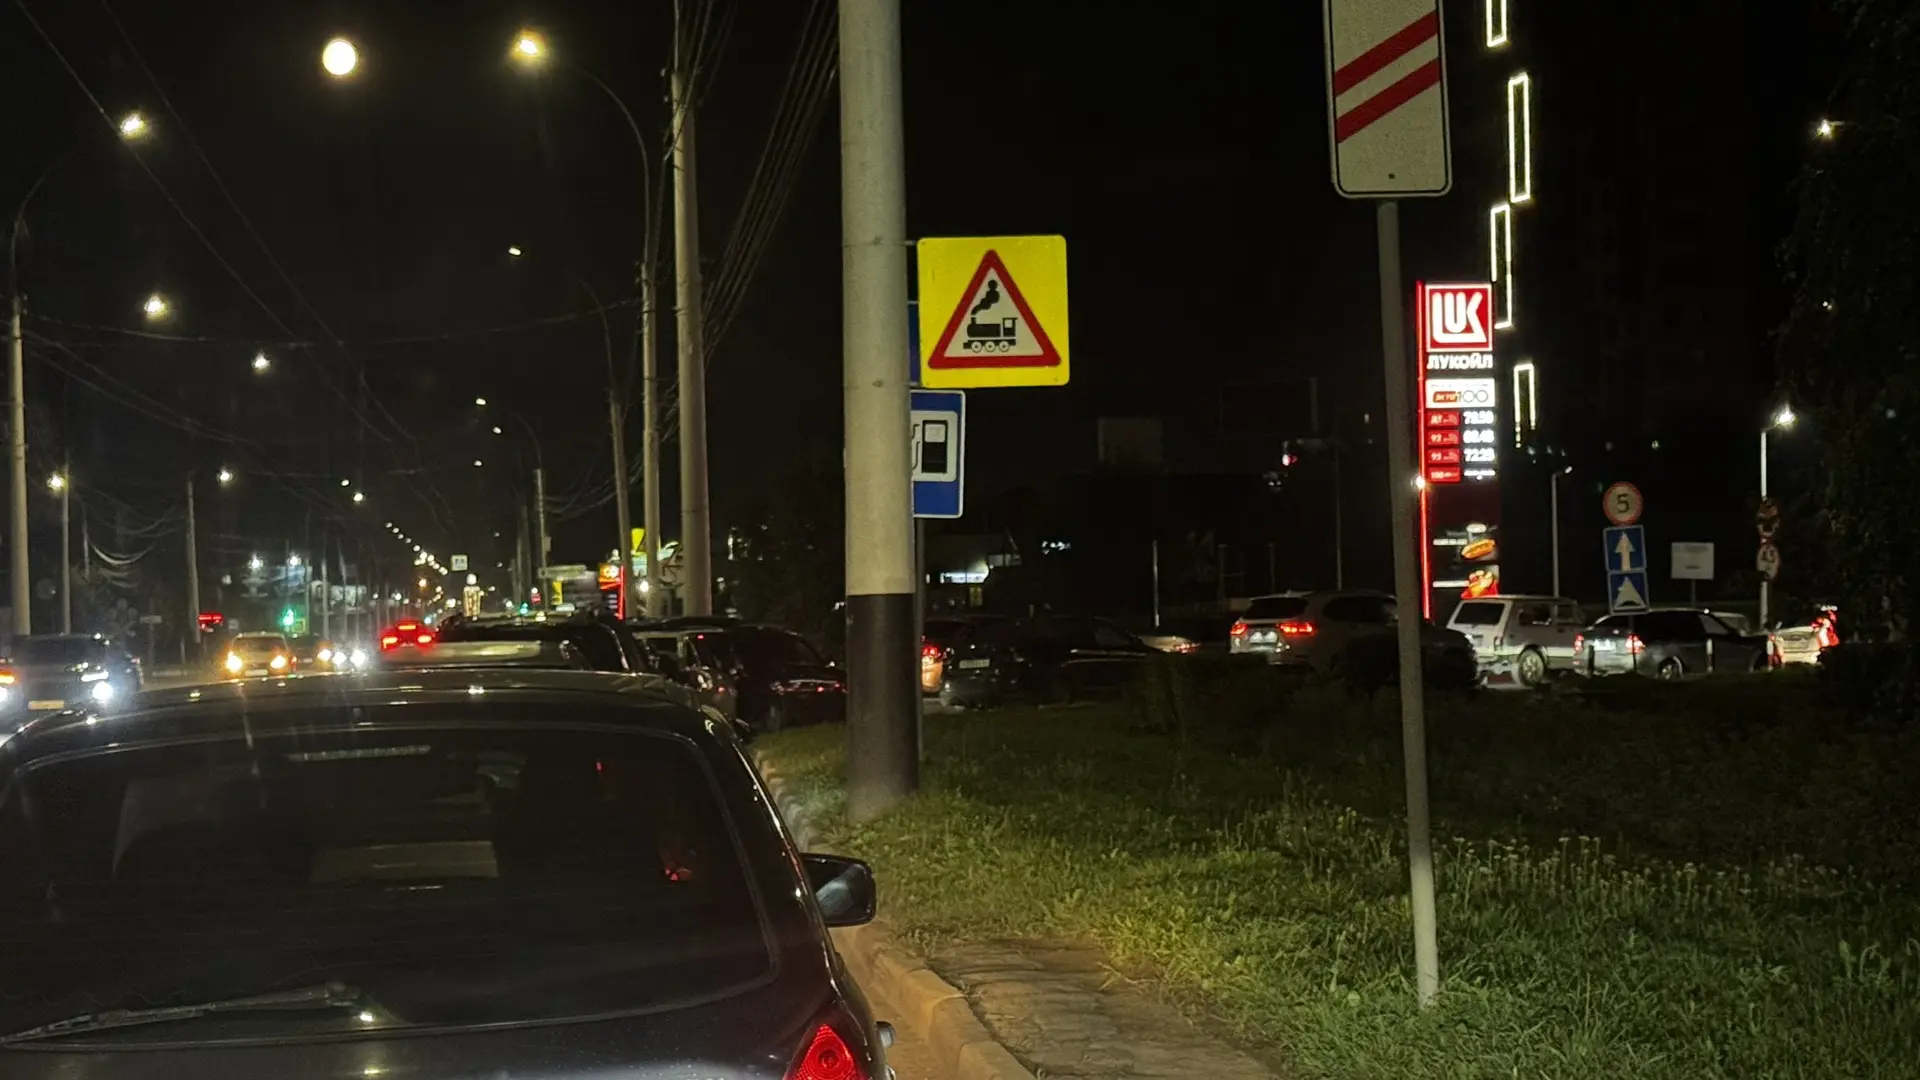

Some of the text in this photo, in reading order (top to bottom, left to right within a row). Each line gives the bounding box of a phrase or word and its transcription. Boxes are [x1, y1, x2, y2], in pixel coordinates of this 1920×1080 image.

[1432, 292, 1487, 343] LUK
[1427, 352, 1494, 369] ЛУКОЙЛ
[1616, 493, 1630, 513] 5
